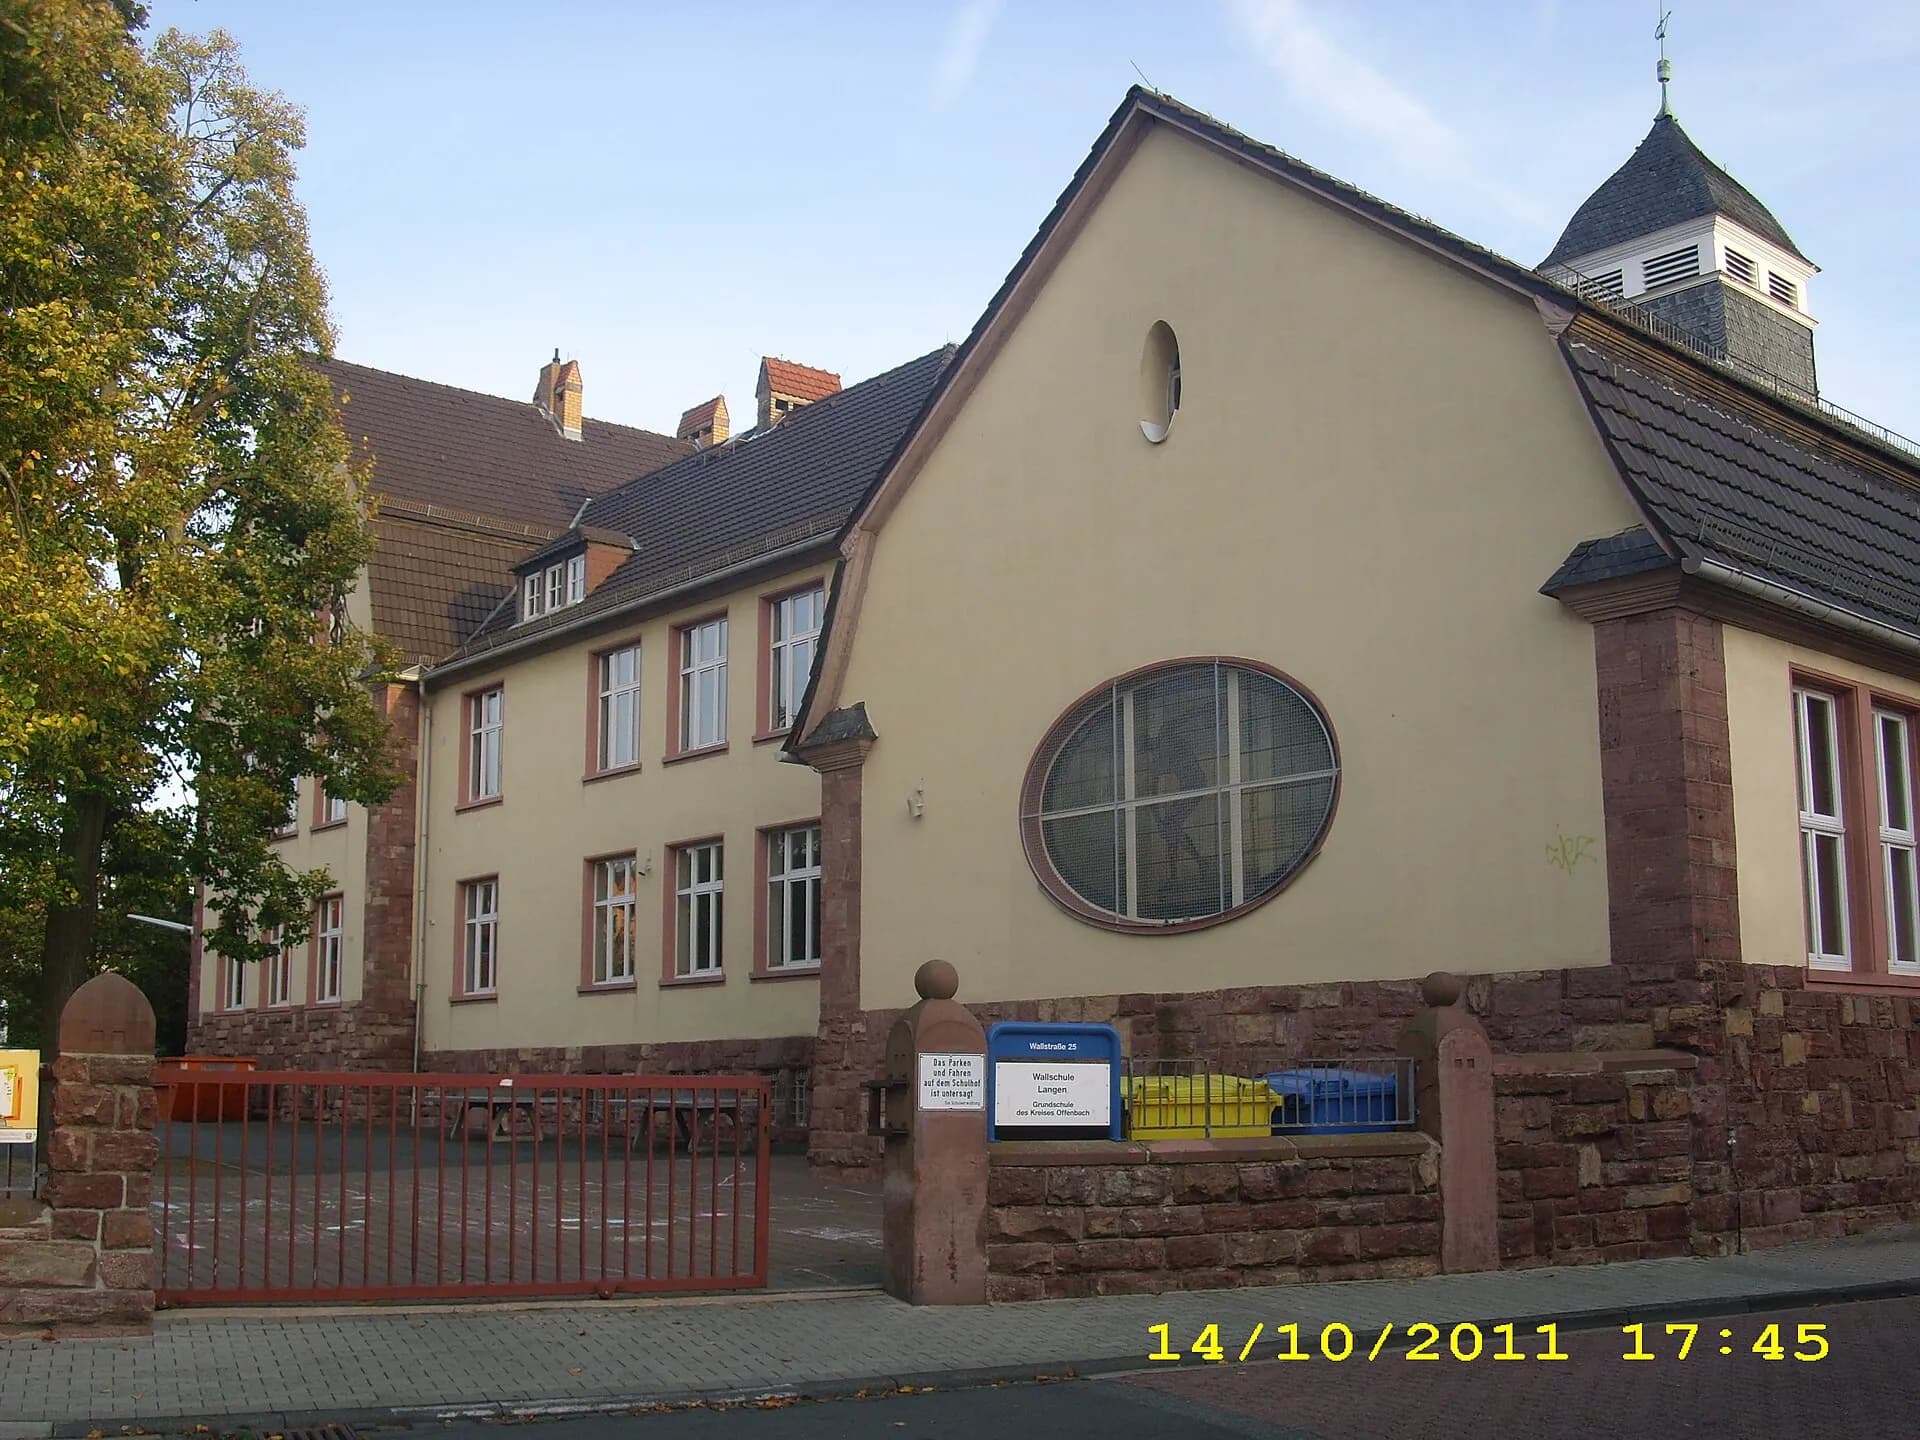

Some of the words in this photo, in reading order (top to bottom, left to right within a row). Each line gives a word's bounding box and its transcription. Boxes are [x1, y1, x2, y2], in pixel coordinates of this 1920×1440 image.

[1029, 1042, 1067, 1050] Wallstraße
[1067, 1043, 1077, 1051] 25
[933, 1058, 945, 1066] Das
[949, 1058, 971, 1066] Parken
[933, 1068, 945, 1076] und
[949, 1068, 971, 1076] Fahren
[1032, 1073, 1075, 1081] Wallschule
[924, 1079, 934, 1087] auf
[936, 1079, 950, 1087] dem
[952, 1078, 981, 1087] Schulhof
[930, 1089, 940, 1097] ist
[942, 1089, 973, 1099] untersagt
[1037, 1085, 1067, 1095] Langen
